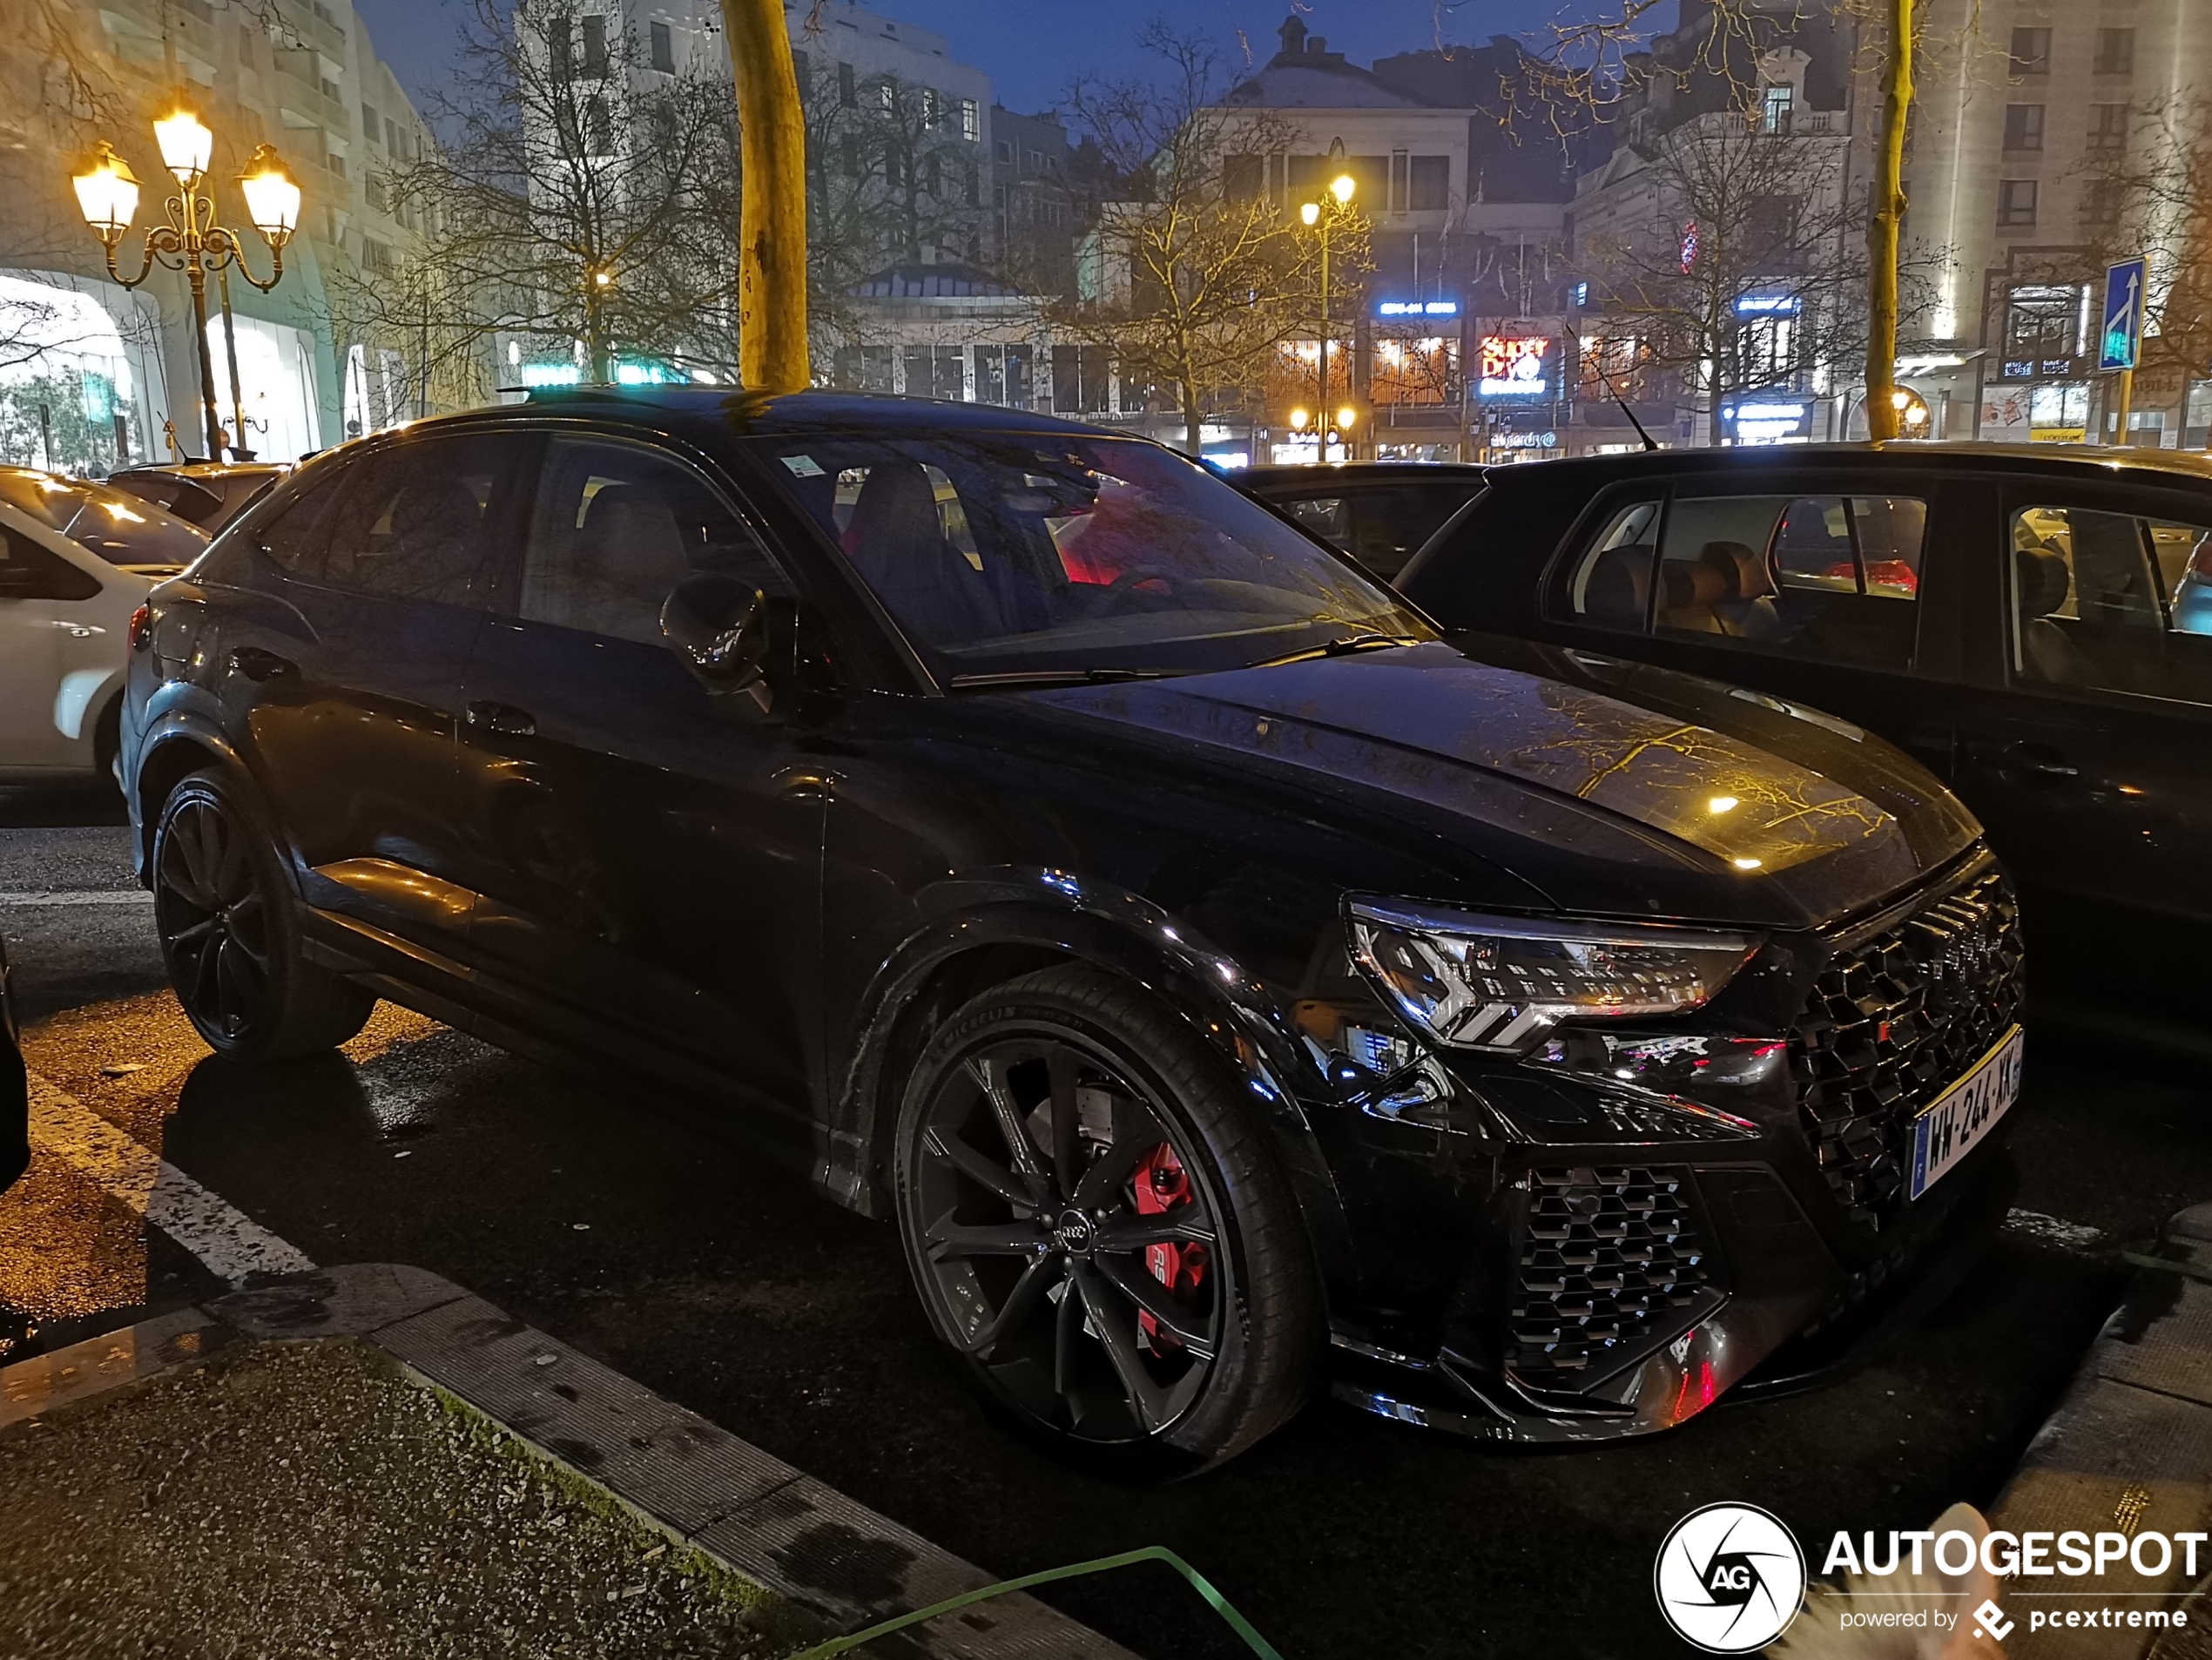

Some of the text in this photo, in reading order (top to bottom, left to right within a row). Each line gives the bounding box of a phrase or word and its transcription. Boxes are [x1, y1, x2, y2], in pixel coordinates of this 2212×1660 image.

[1481, 336, 1548, 362] Super
[1481, 358, 1517, 380] Dry
[943, 1006, 1016, 1048] MICHELIN
[1154, 1245, 1166, 1285] RS
